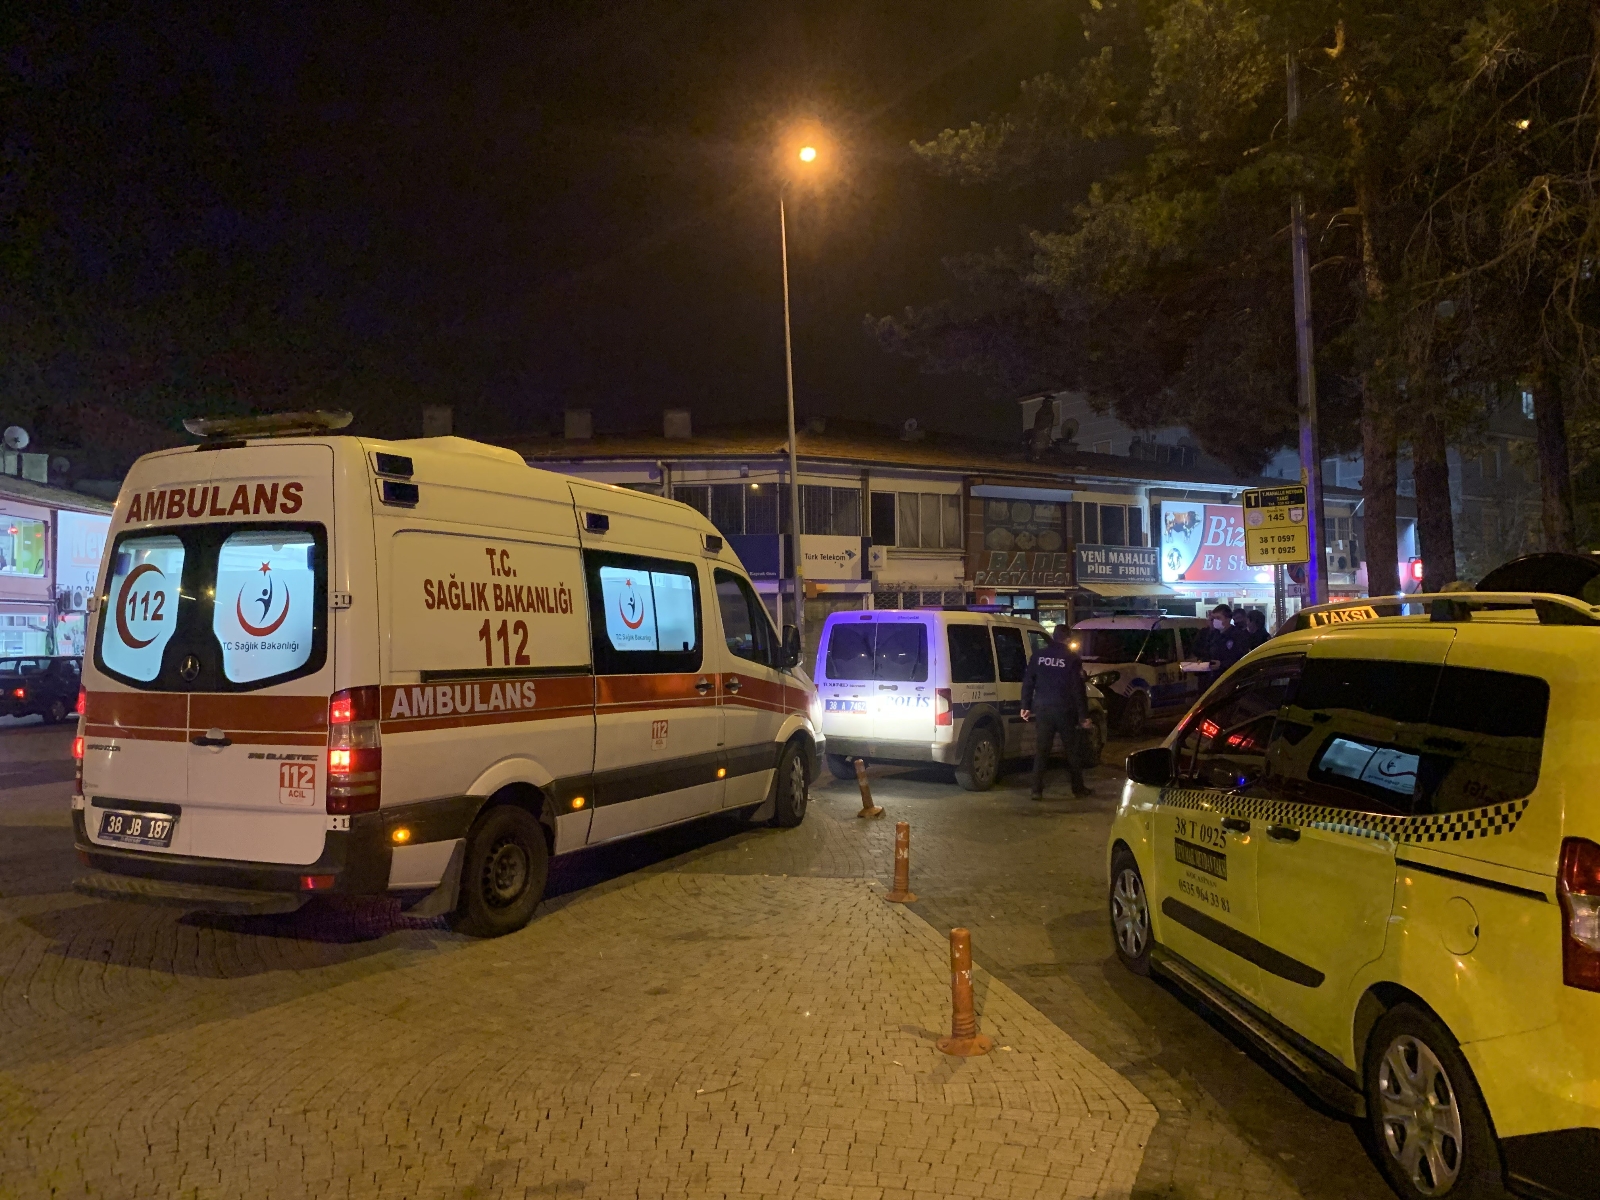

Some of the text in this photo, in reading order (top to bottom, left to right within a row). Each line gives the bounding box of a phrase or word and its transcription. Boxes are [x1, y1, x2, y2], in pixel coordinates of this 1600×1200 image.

[125, 482, 304, 524] AMBULANS
[1267, 513, 1285, 522] 145
[1259, 534, 1295, 544] 38 T 0597
[804, 552, 846, 561] Türk Telekom
[986, 550, 1067, 571] BADE
[1081, 549, 1156, 566] YENİ MAHALLE
[1260, 547, 1269, 555] 38
[1278, 546, 1296, 554] 0925
[485, 547, 517, 578] T.C.
[1087, 563, 1113, 574] PİDE
[1202, 554, 1221, 571] Et
[423, 573, 574, 615] SAĞLIK BAKANLIĞI
[127, 590, 166, 622] 112
[234, 641, 259, 652] Sağlık
[260, 641, 300, 653] Bakanlığı
[478, 618, 531, 667] 112
[390, 681, 537, 719] AMBULANS
[829, 701, 838, 710] 38
[841, 702, 846, 711] A
[652, 721, 668, 738] 112
[281, 764, 314, 789] 112
[107, 815, 171, 839] 38 JB 187
[1174, 816, 1227, 849] 38 T 0925
[1178, 879, 1231, 913] 0535 964 33 81
